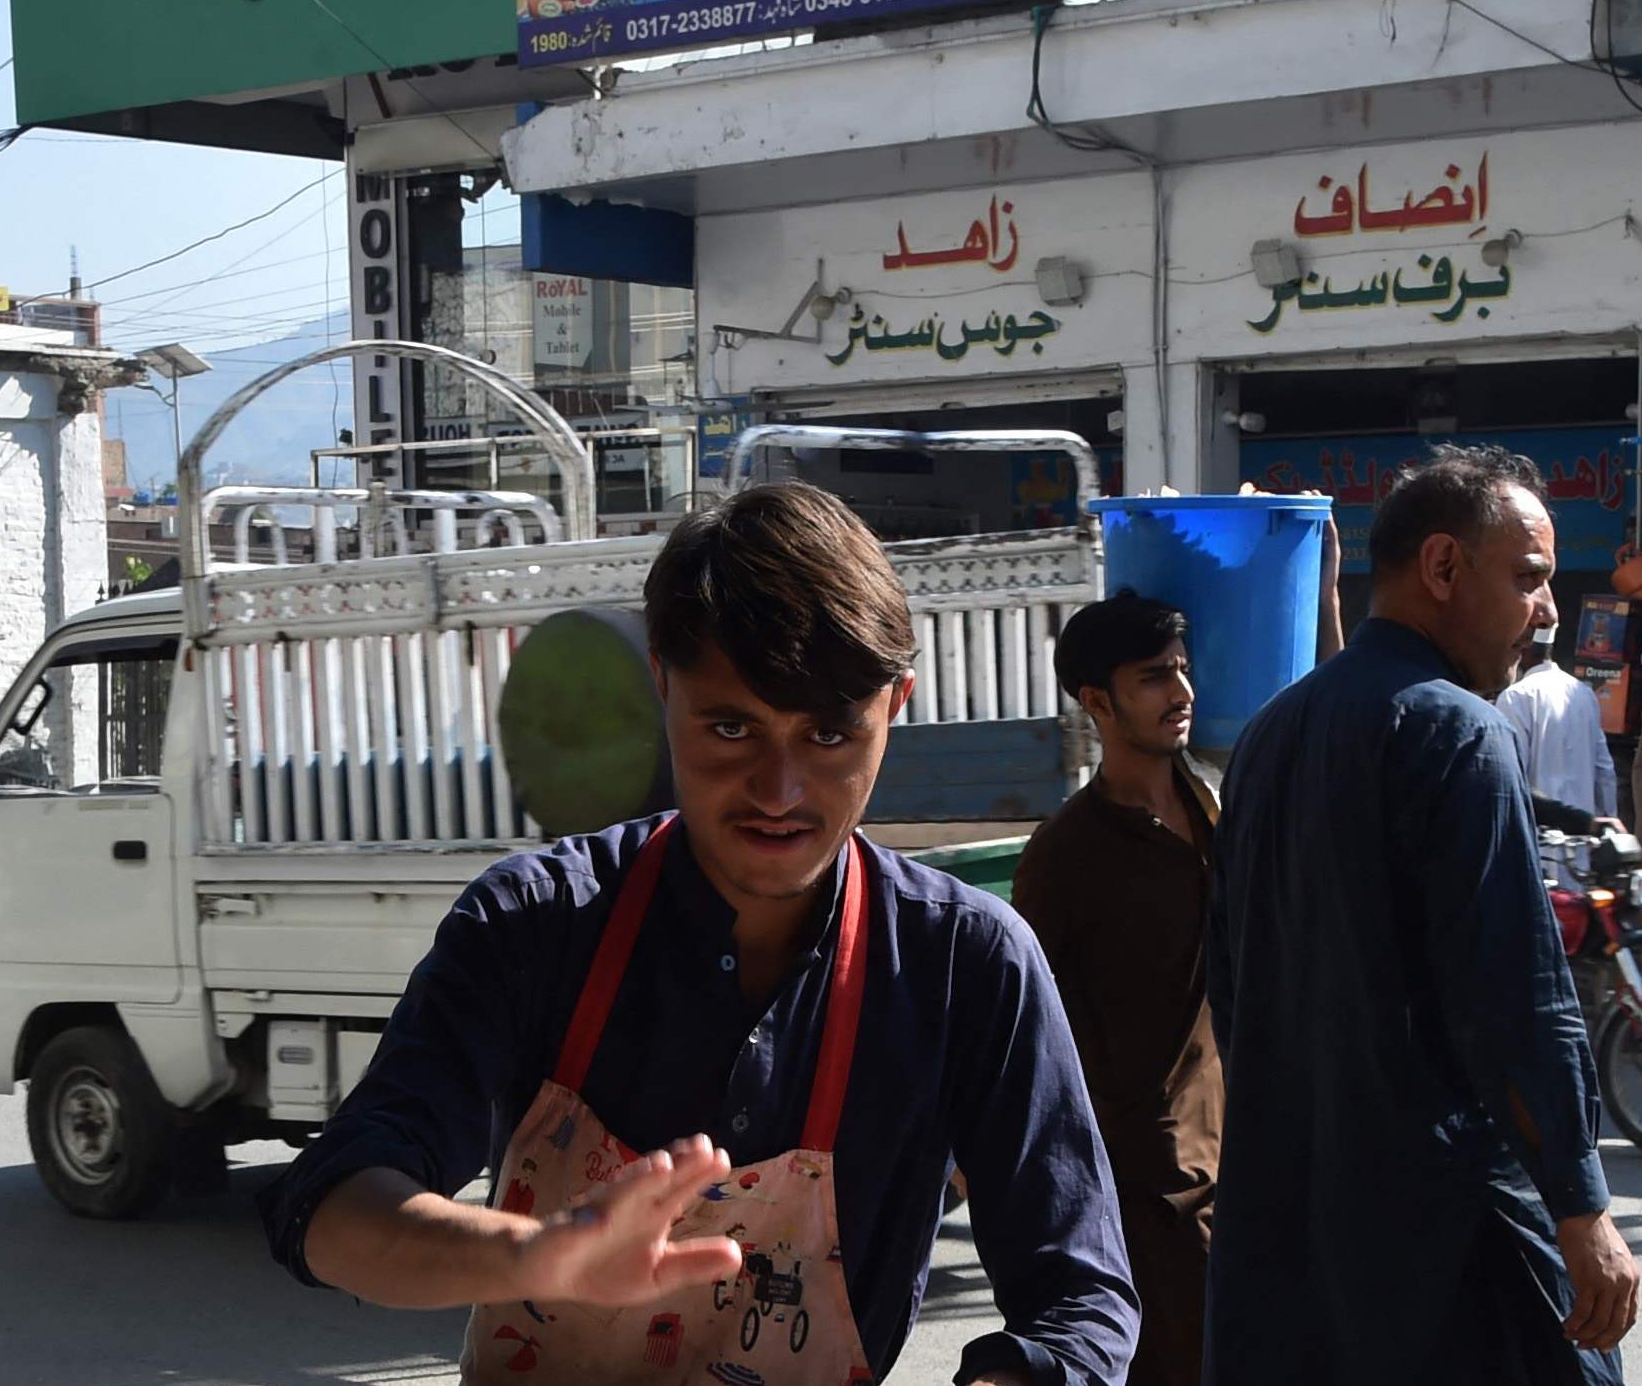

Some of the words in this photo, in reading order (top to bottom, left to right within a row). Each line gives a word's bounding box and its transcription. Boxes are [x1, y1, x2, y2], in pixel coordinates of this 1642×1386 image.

[626, 4, 757, 41] 0317-2338877
[531, 31, 568, 54] 1980
[1393, 253, 1511, 323] برف
[557, 325, 567, 337] &
